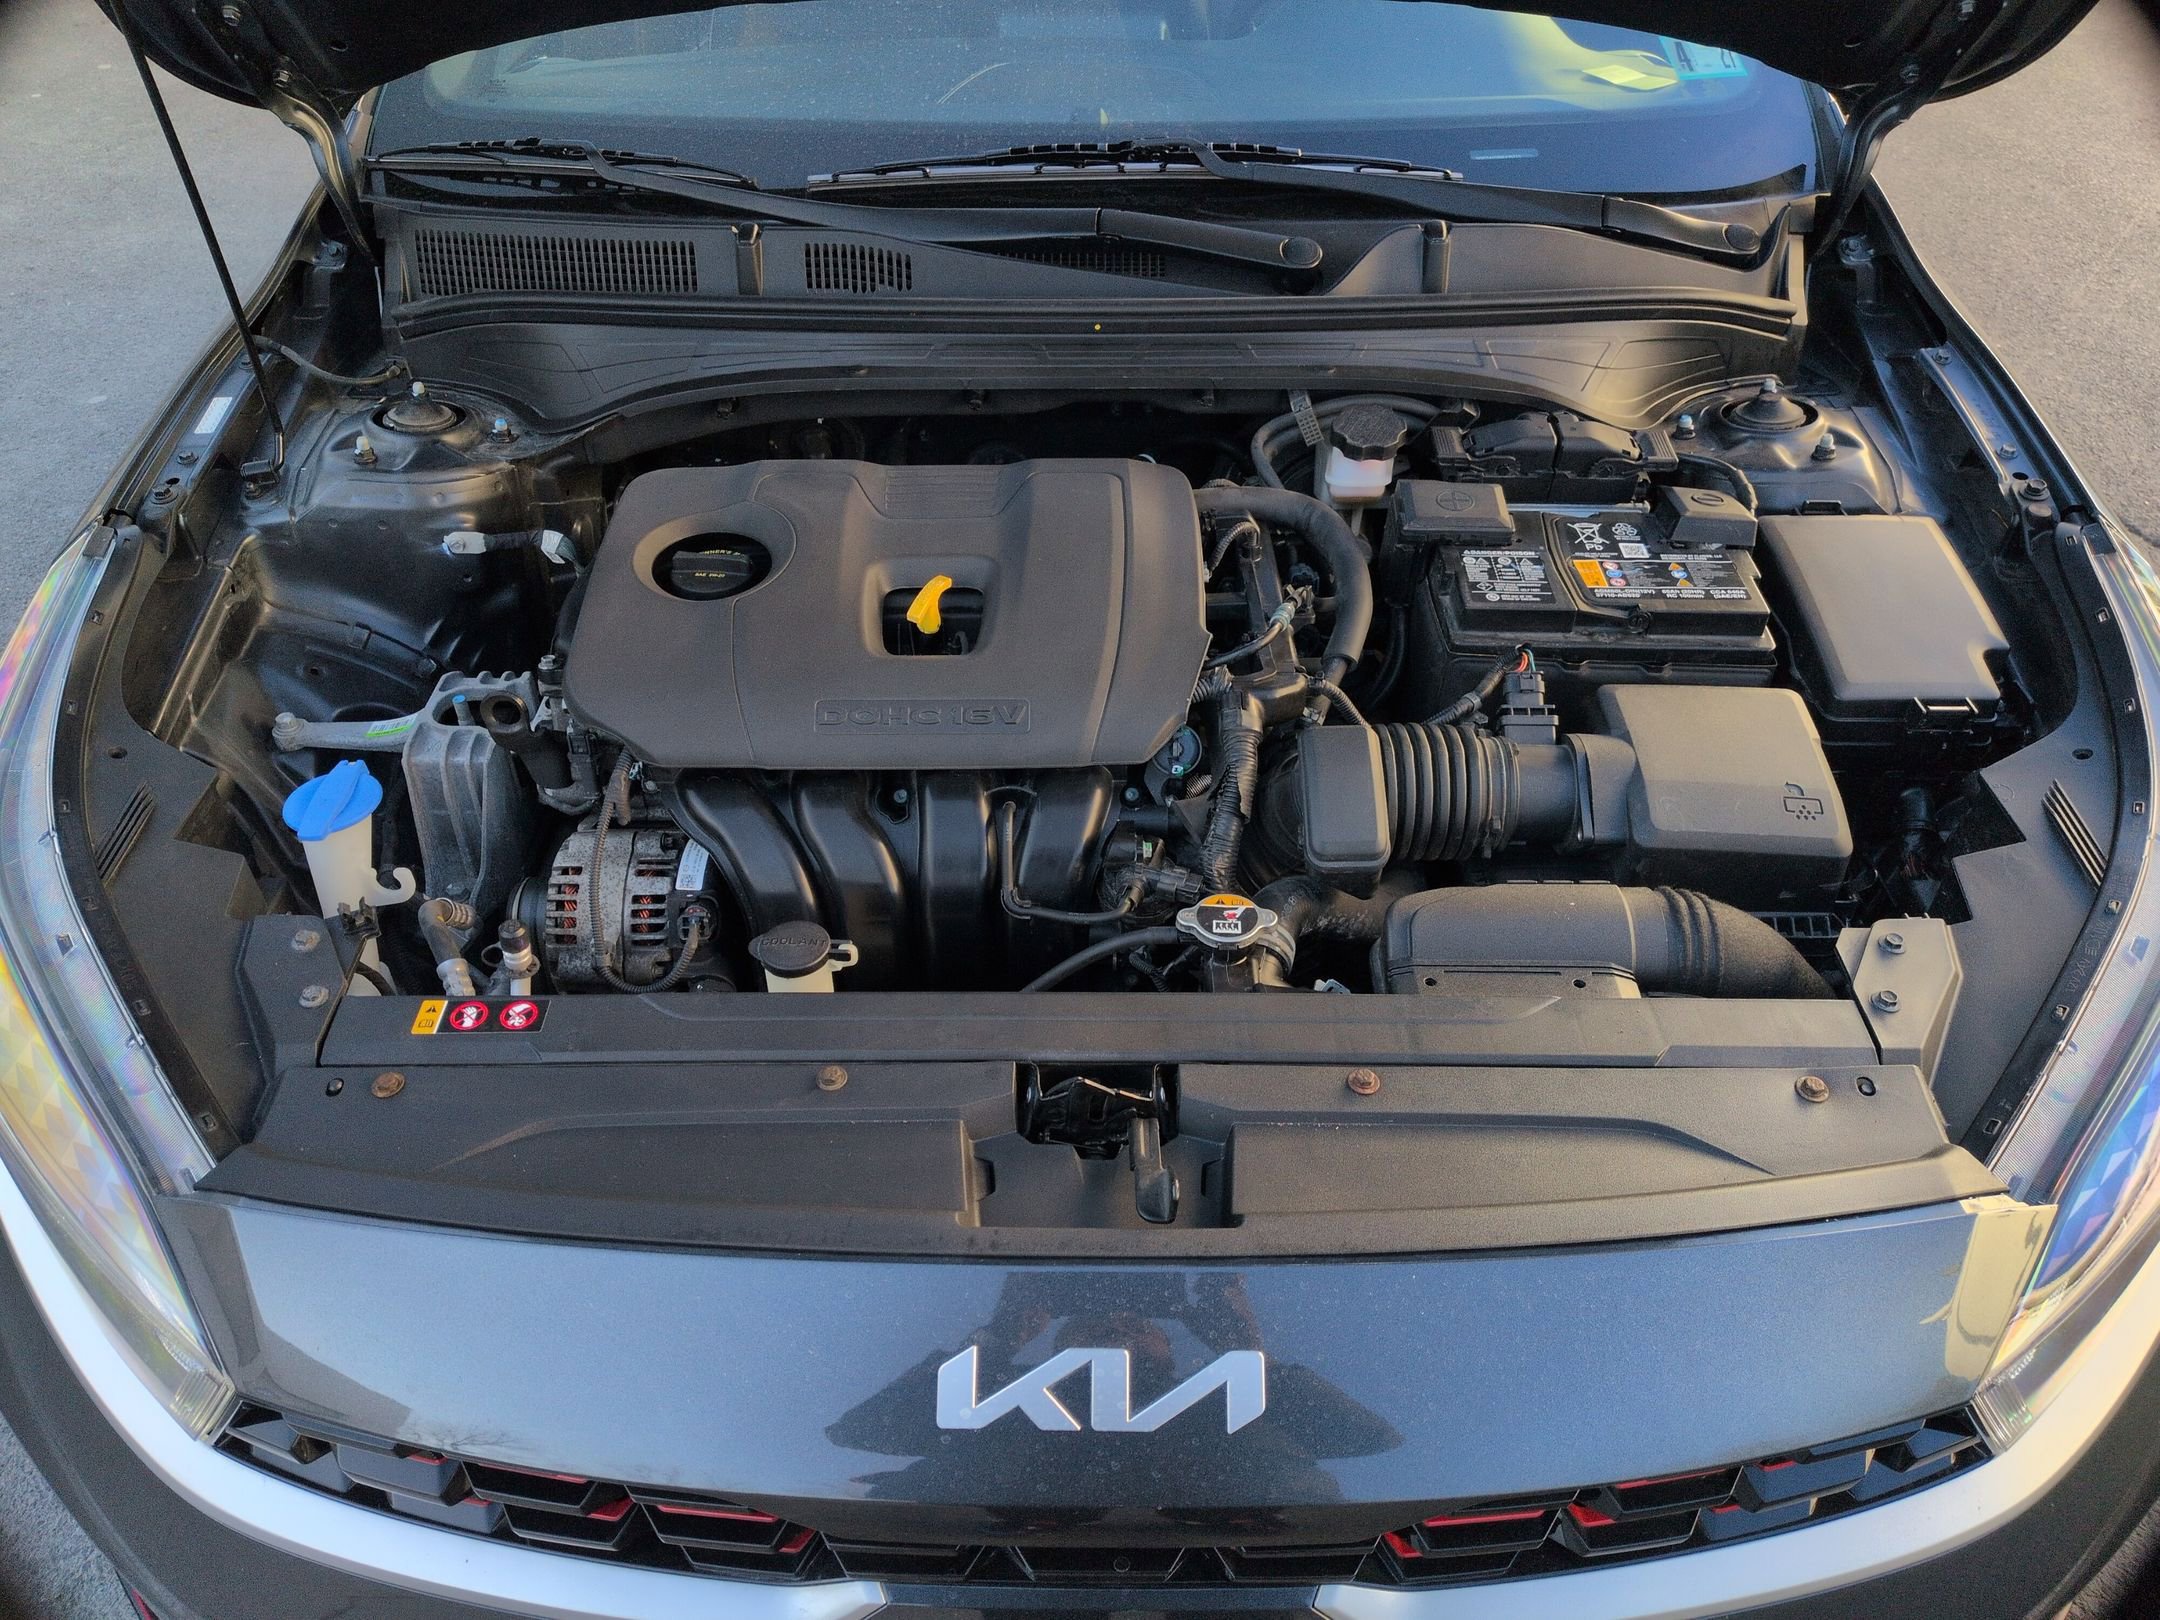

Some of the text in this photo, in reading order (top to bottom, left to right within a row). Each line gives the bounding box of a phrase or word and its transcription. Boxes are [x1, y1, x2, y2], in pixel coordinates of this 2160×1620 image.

[1585, 543, 1604, 551] Pb
[816, 706, 1027, 726] DOHC 16V
[761, 936, 828, 948] COOLANT
[936, 1345, 1266, 1434] KIA
